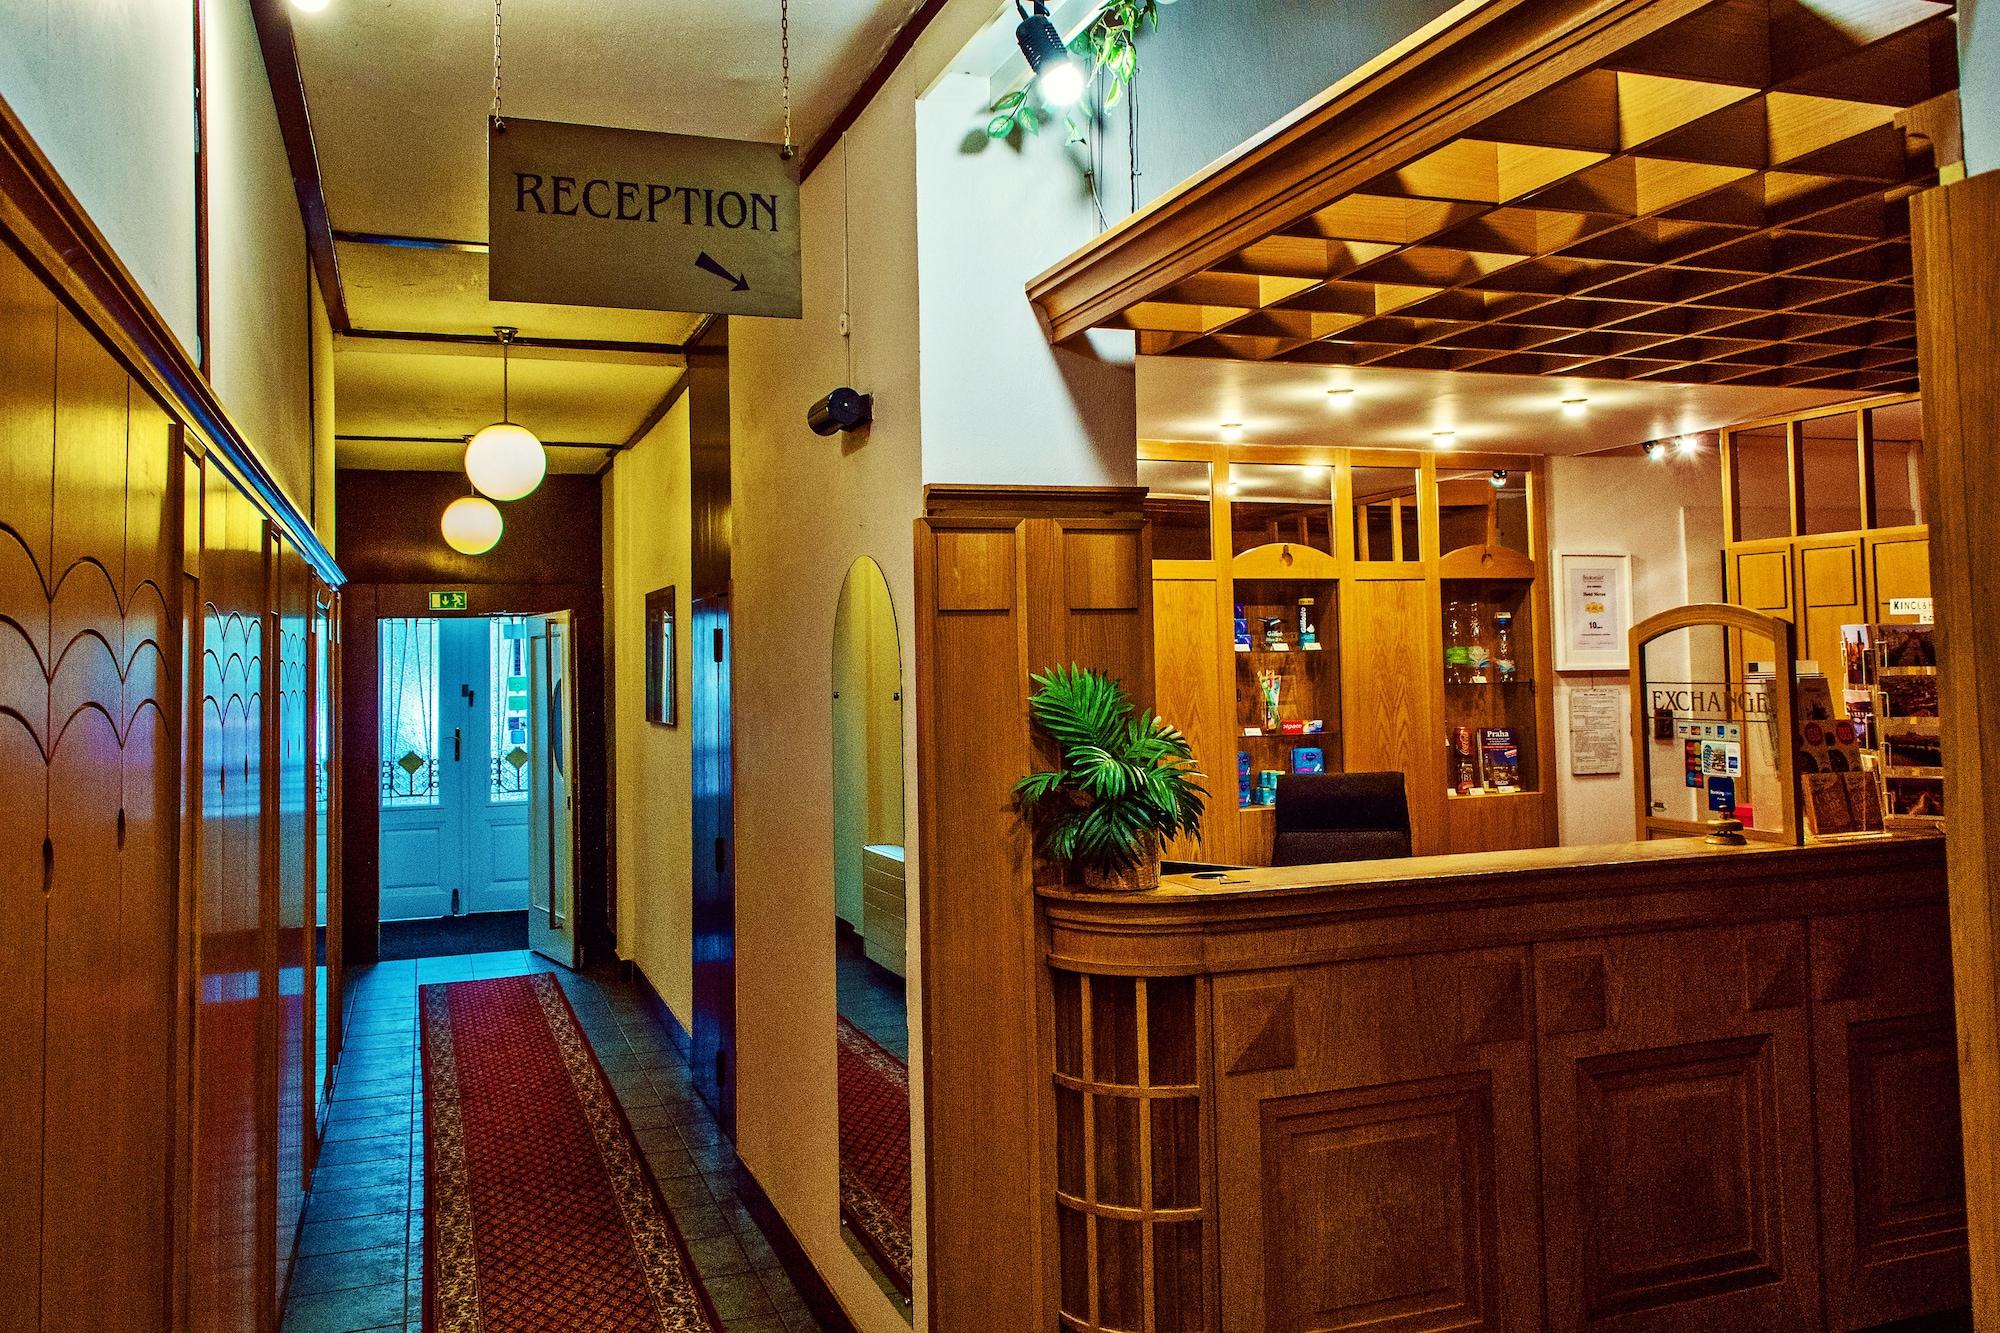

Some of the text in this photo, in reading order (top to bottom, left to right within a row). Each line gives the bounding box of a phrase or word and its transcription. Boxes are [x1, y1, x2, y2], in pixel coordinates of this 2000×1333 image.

[515, 172, 779, 232] RECEPTION
[1652, 690, 1768, 713] EXCHANGE
[1487, 730, 1509, 738] Praha
